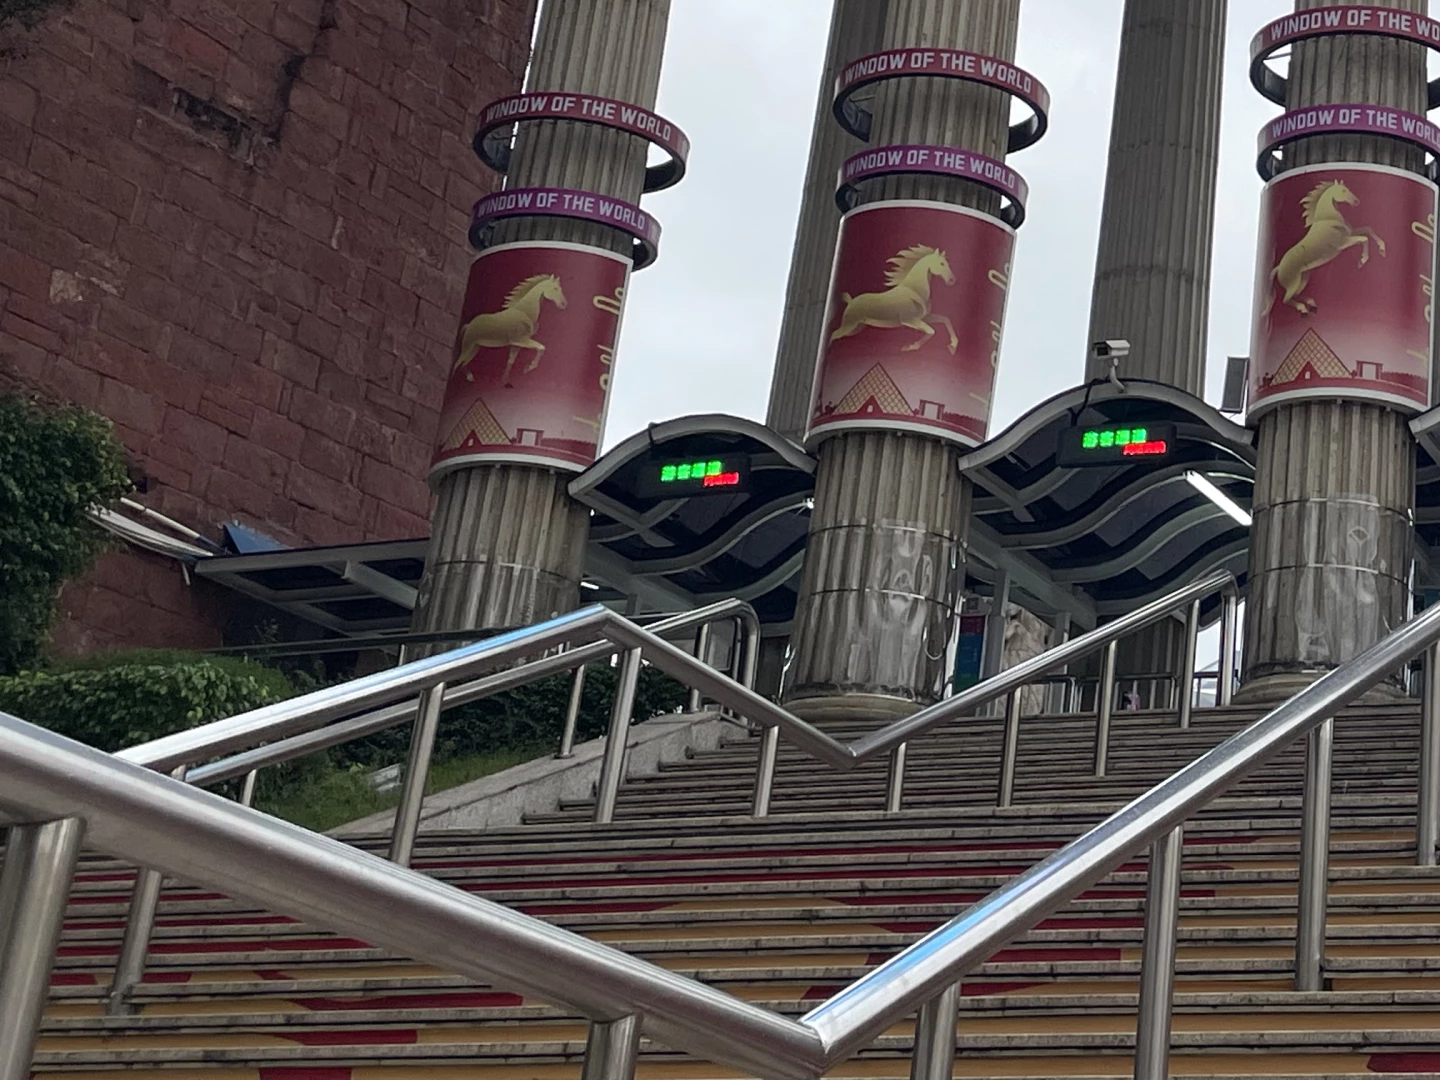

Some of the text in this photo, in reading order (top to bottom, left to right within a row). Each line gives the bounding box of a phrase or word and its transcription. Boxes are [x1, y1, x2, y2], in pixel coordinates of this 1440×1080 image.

[1270, 10, 1343, 41] WINDOW
[1347, 9, 1371, 26] OF
[1376, 10, 1412, 32] THE
[845, 52, 1031, 94] WINDOW OF THE WORLD
[486, 96, 671, 141] WINDOW OF THE WORLD
[1272, 109, 1334, 138] WINDOW
[1339, 109, 1361, 124] OF
[1366, 110, 1397, 129] THE
[846, 150, 1015, 189] WINDOW OF THE WORLD
[478, 192, 646, 230] WINDOW OF THE WORLD
